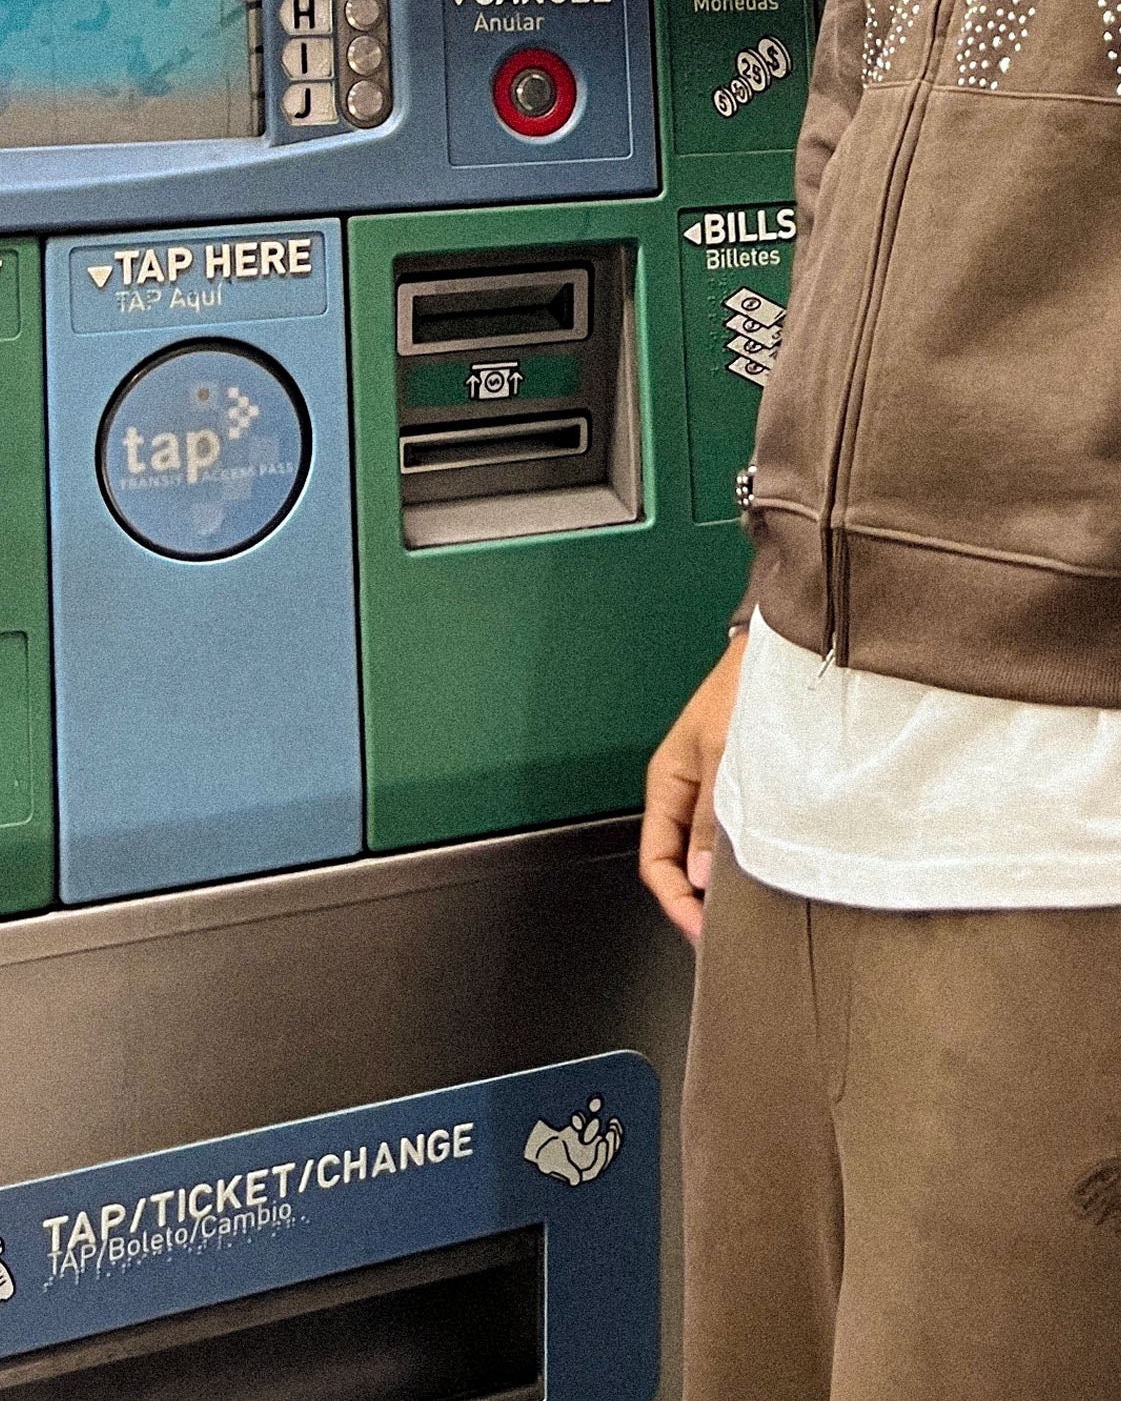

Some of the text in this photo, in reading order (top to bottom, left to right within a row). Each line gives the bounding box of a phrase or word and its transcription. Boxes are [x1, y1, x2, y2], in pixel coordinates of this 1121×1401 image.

[474, 11, 545, 33] Anular
[301, 42, 308, 75] I
[294, 87, 311, 119] J
[704, 208, 797, 246] BILLS
[114, 238, 313, 286] TAP HERE
[706, 249, 781, 270] Billetes
[114, 281, 223, 314] TAP Aquí
[122, 426, 221, 485] tap
[42, 1122, 476, 1253] TAP/TICKET/CHANGE
[47, 1200, 293, 1276] TAP/Boleto/Cambio
